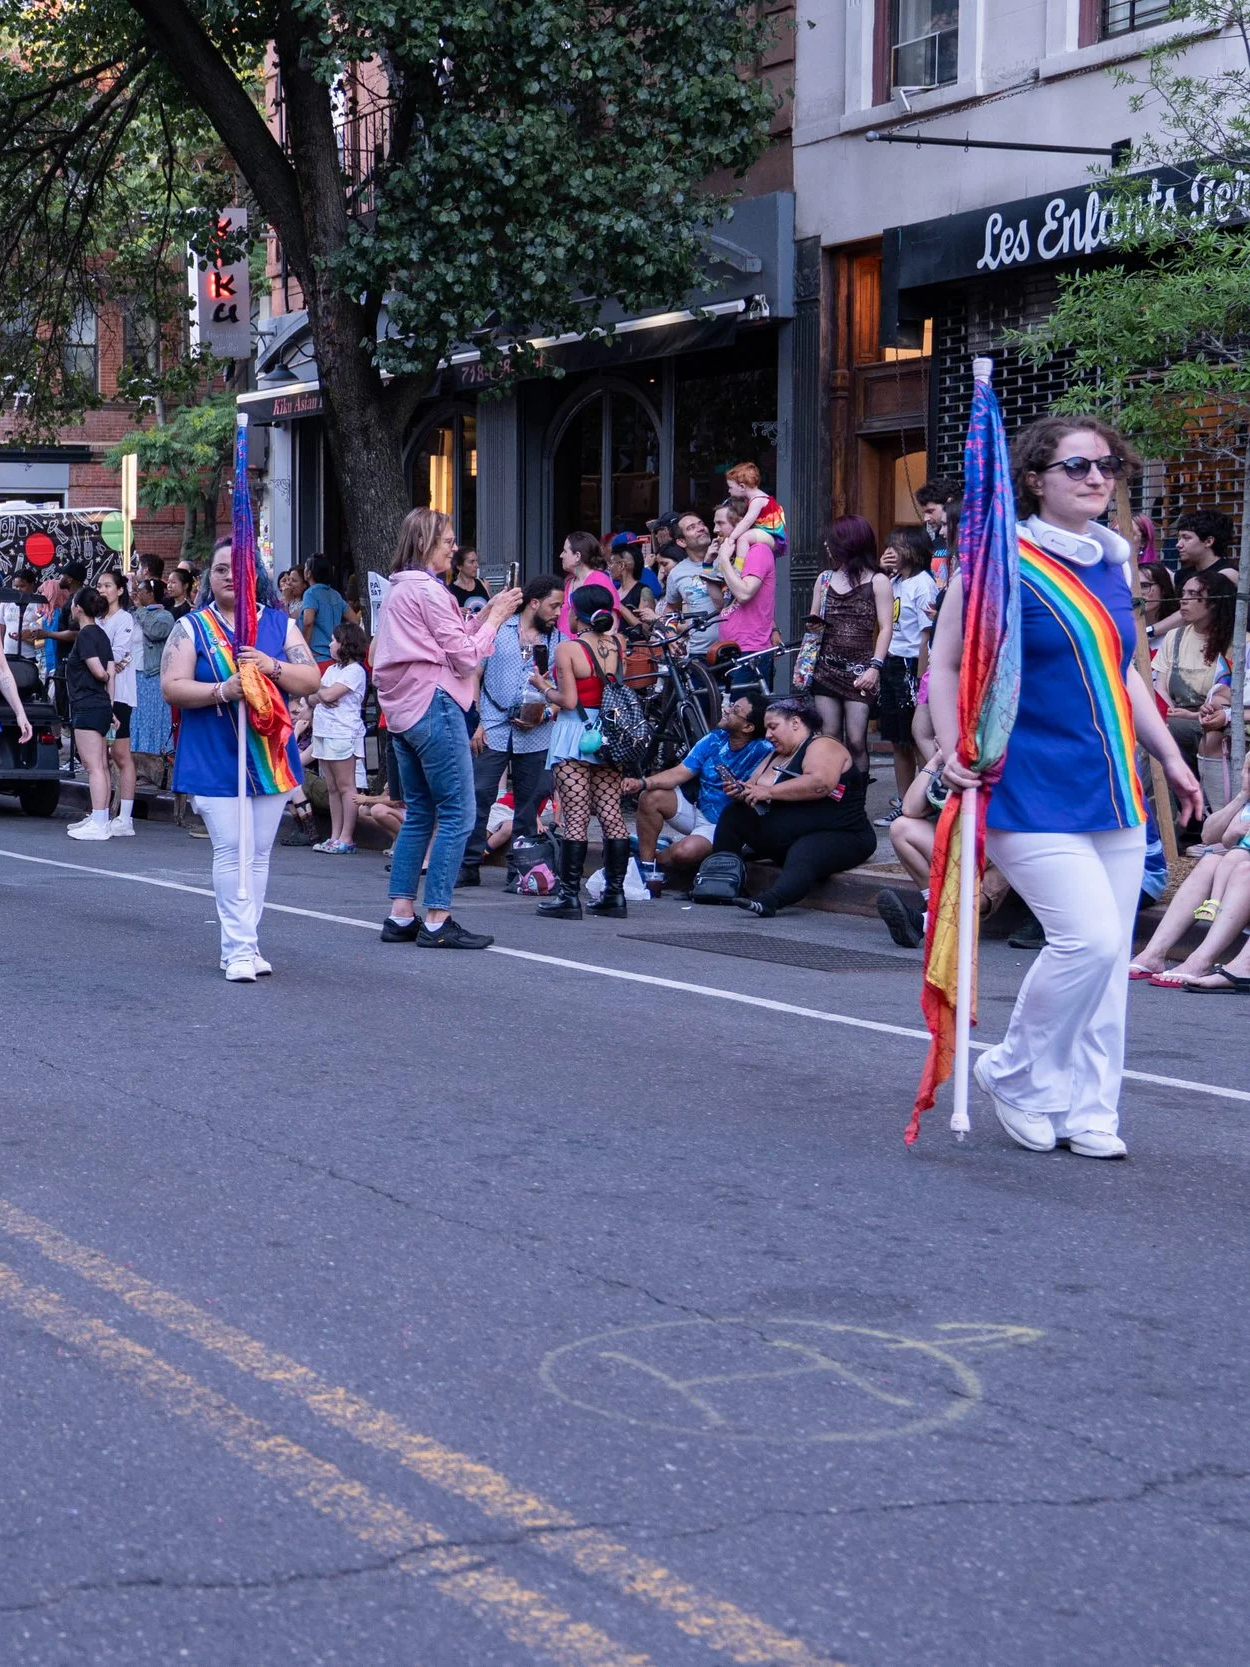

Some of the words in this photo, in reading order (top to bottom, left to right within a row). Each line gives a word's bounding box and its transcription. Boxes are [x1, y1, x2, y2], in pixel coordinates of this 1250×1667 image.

[976, 212, 1031, 270] Les
[272, 398, 292, 415] Kiku
[293, 394, 318, 411] Asian
